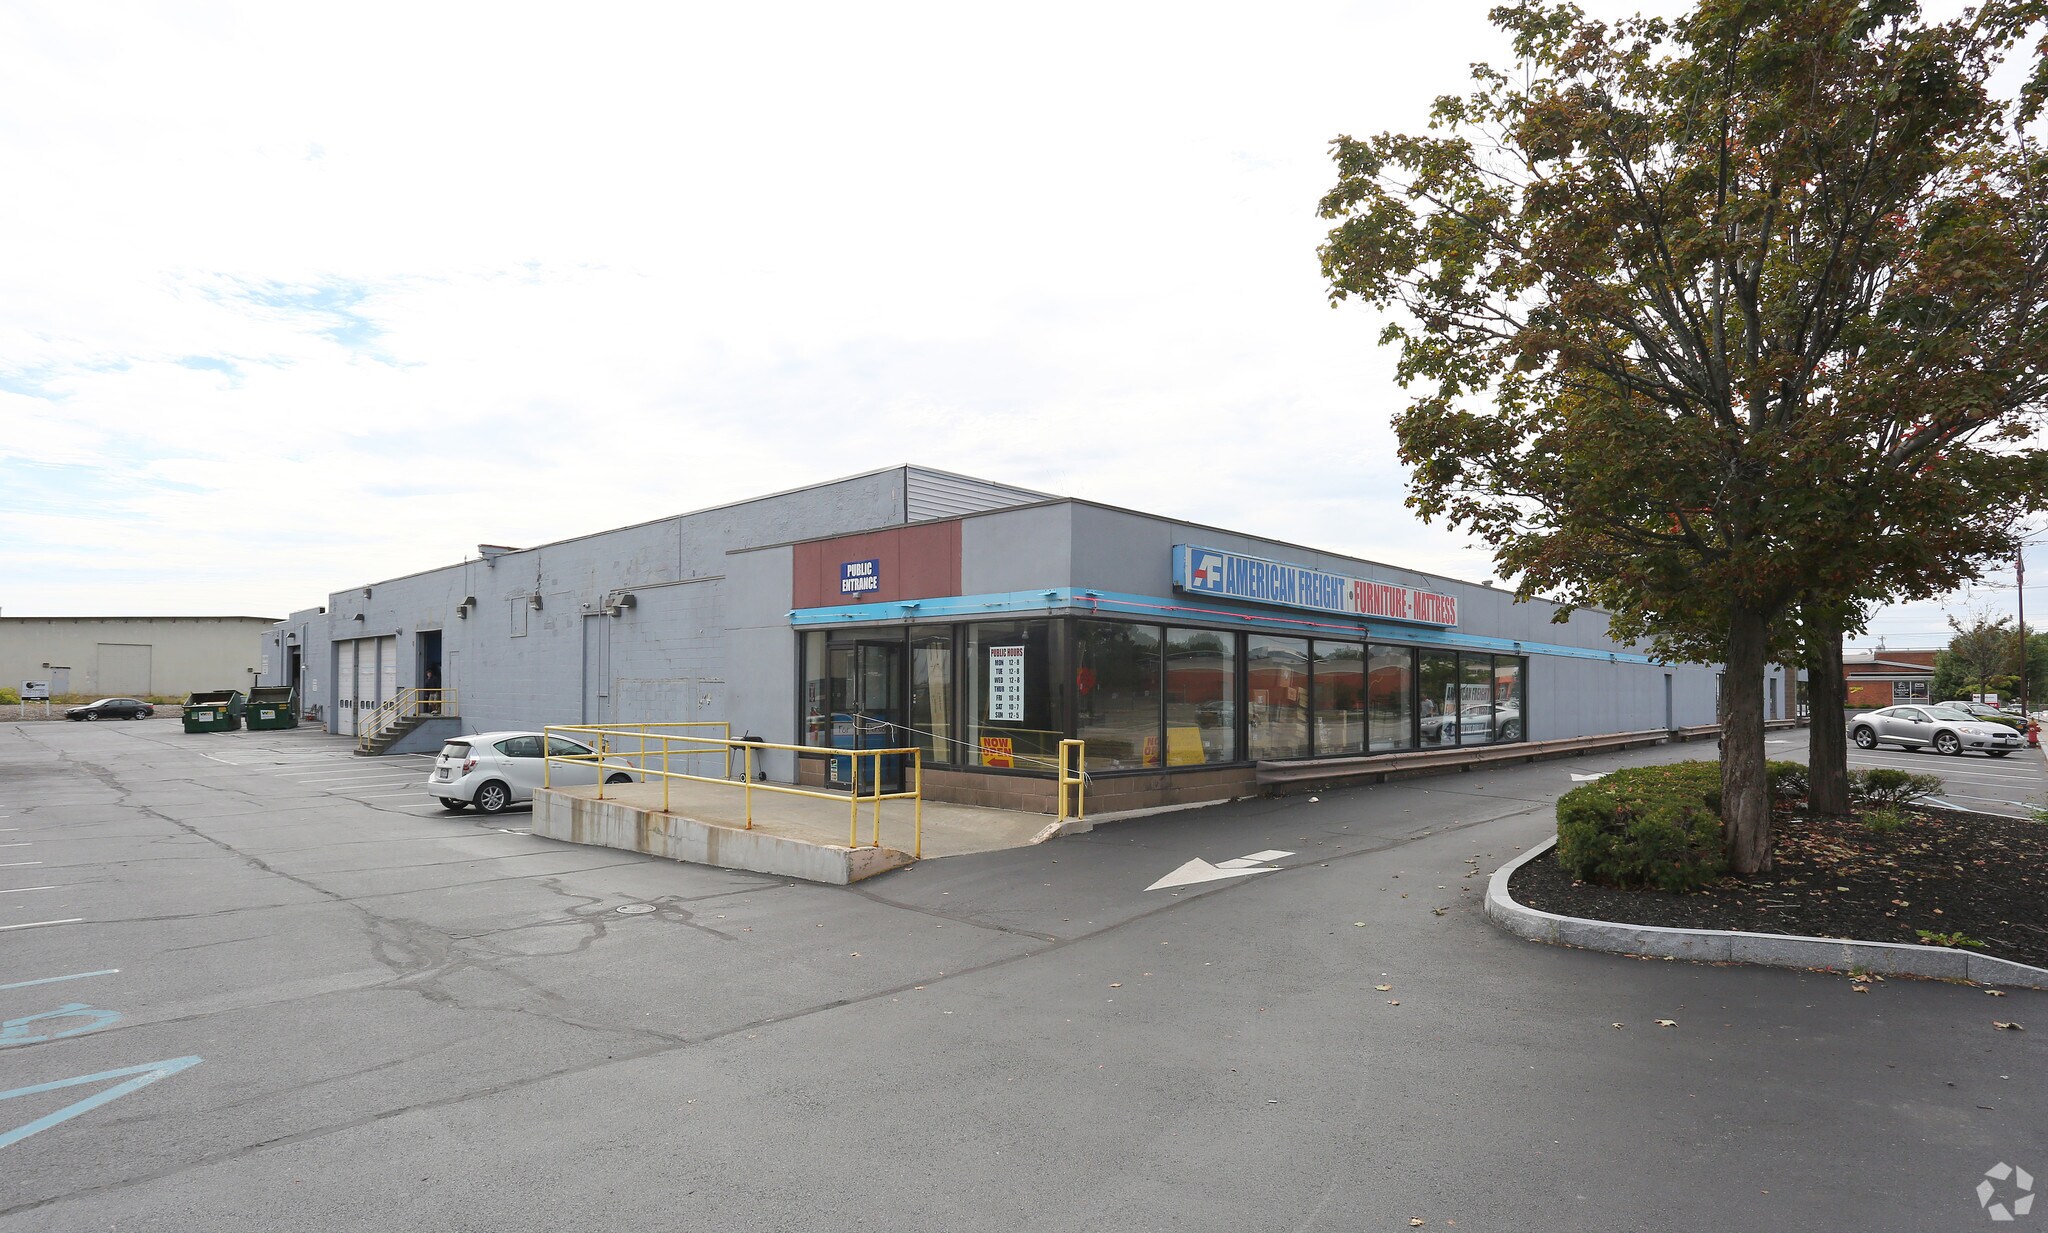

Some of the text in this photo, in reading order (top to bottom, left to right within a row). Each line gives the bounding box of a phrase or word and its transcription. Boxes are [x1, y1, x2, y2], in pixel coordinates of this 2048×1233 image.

[847, 561, 873, 577] PUBLIC
[842, 575, 878, 592] ENTRANCE
[1226, 556, 1296, 603] AMERICAN
[1298, 570, 1345, 611] FREIGHT
[1354, 580, 1408, 618] FURNITURE
[1413, 590, 1457, 625] MATTRESS
[991, 648, 1023, 658] PUBLIC HOURS
[984, 738, 1008, 747] NOW
